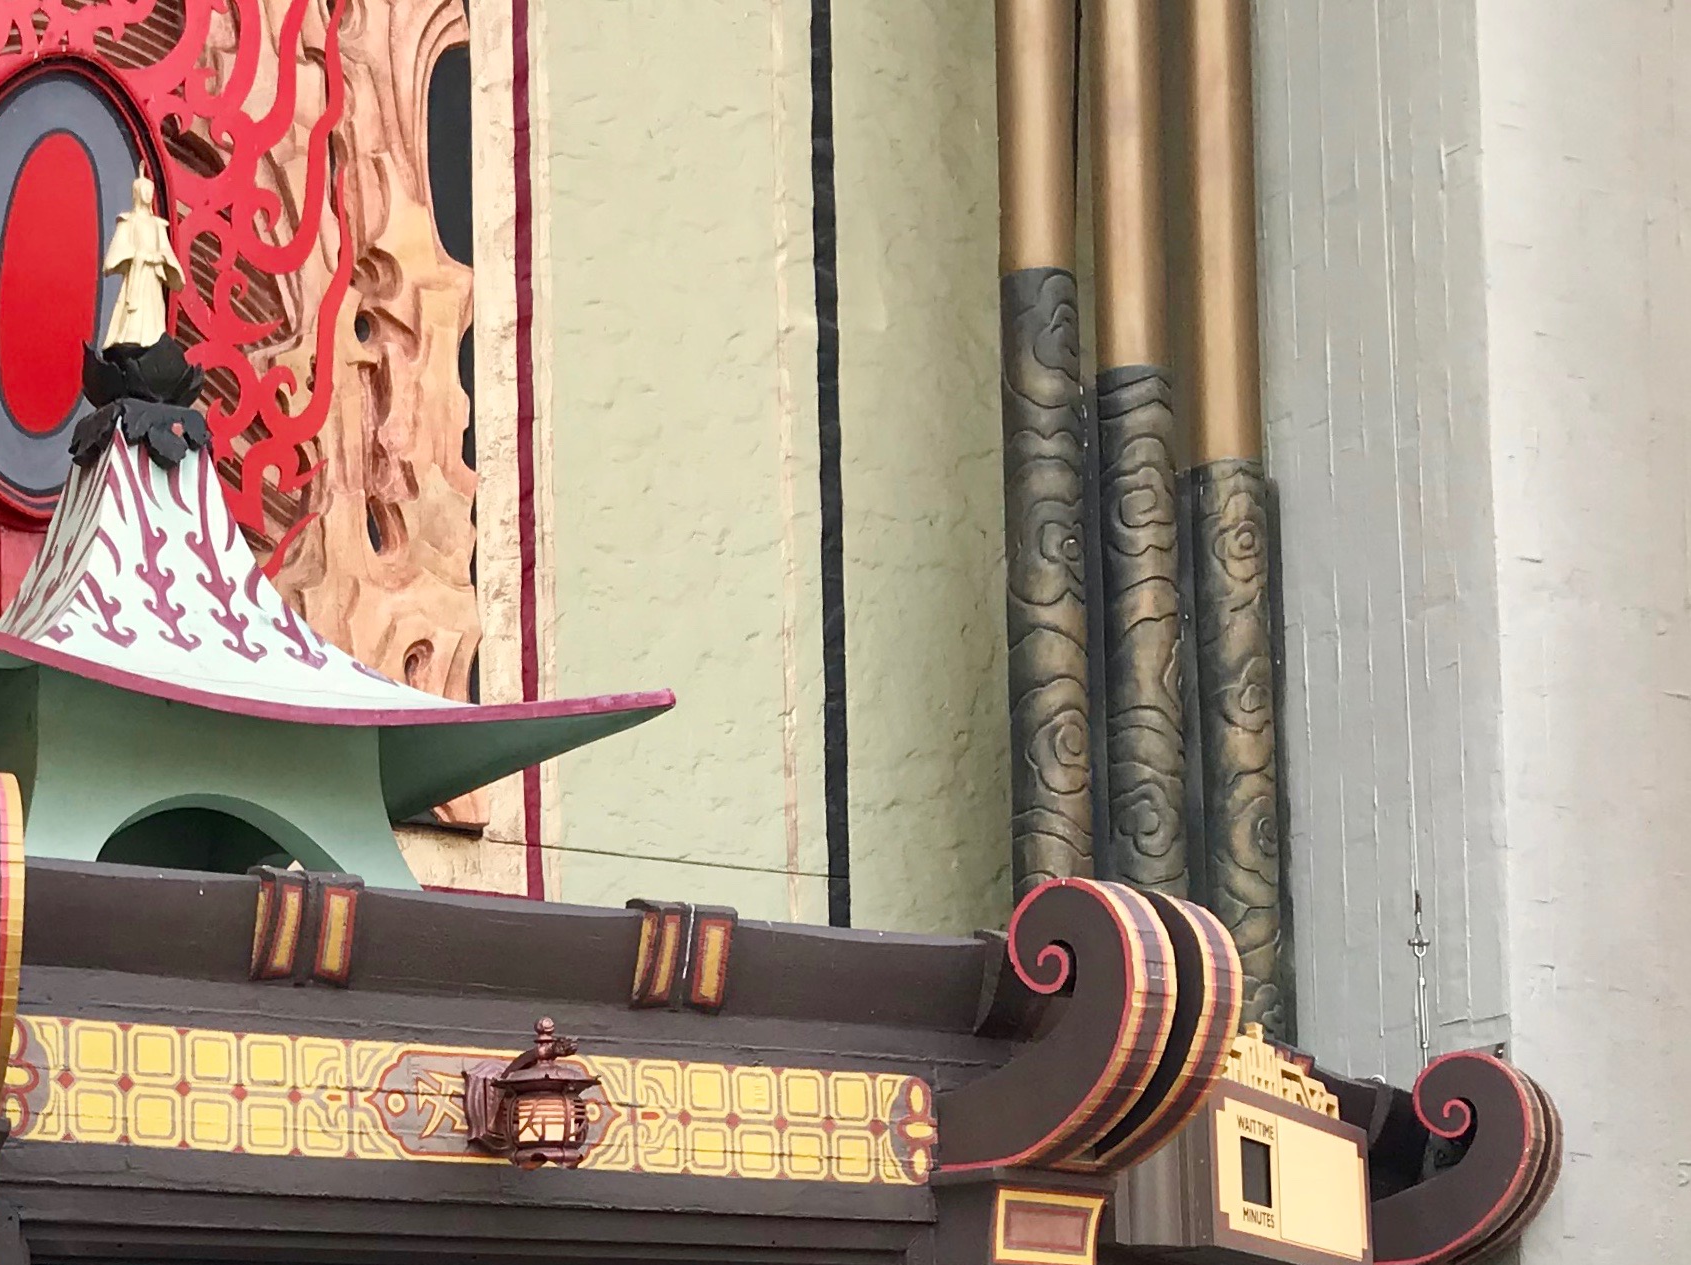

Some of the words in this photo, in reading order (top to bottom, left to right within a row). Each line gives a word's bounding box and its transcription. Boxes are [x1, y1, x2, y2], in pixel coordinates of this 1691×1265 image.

[1236, 1114, 1256, 1134] WAIT
[1257, 1120, 1274, 1140] TIME
[1242, 1207, 1275, 1229] MINUTES
